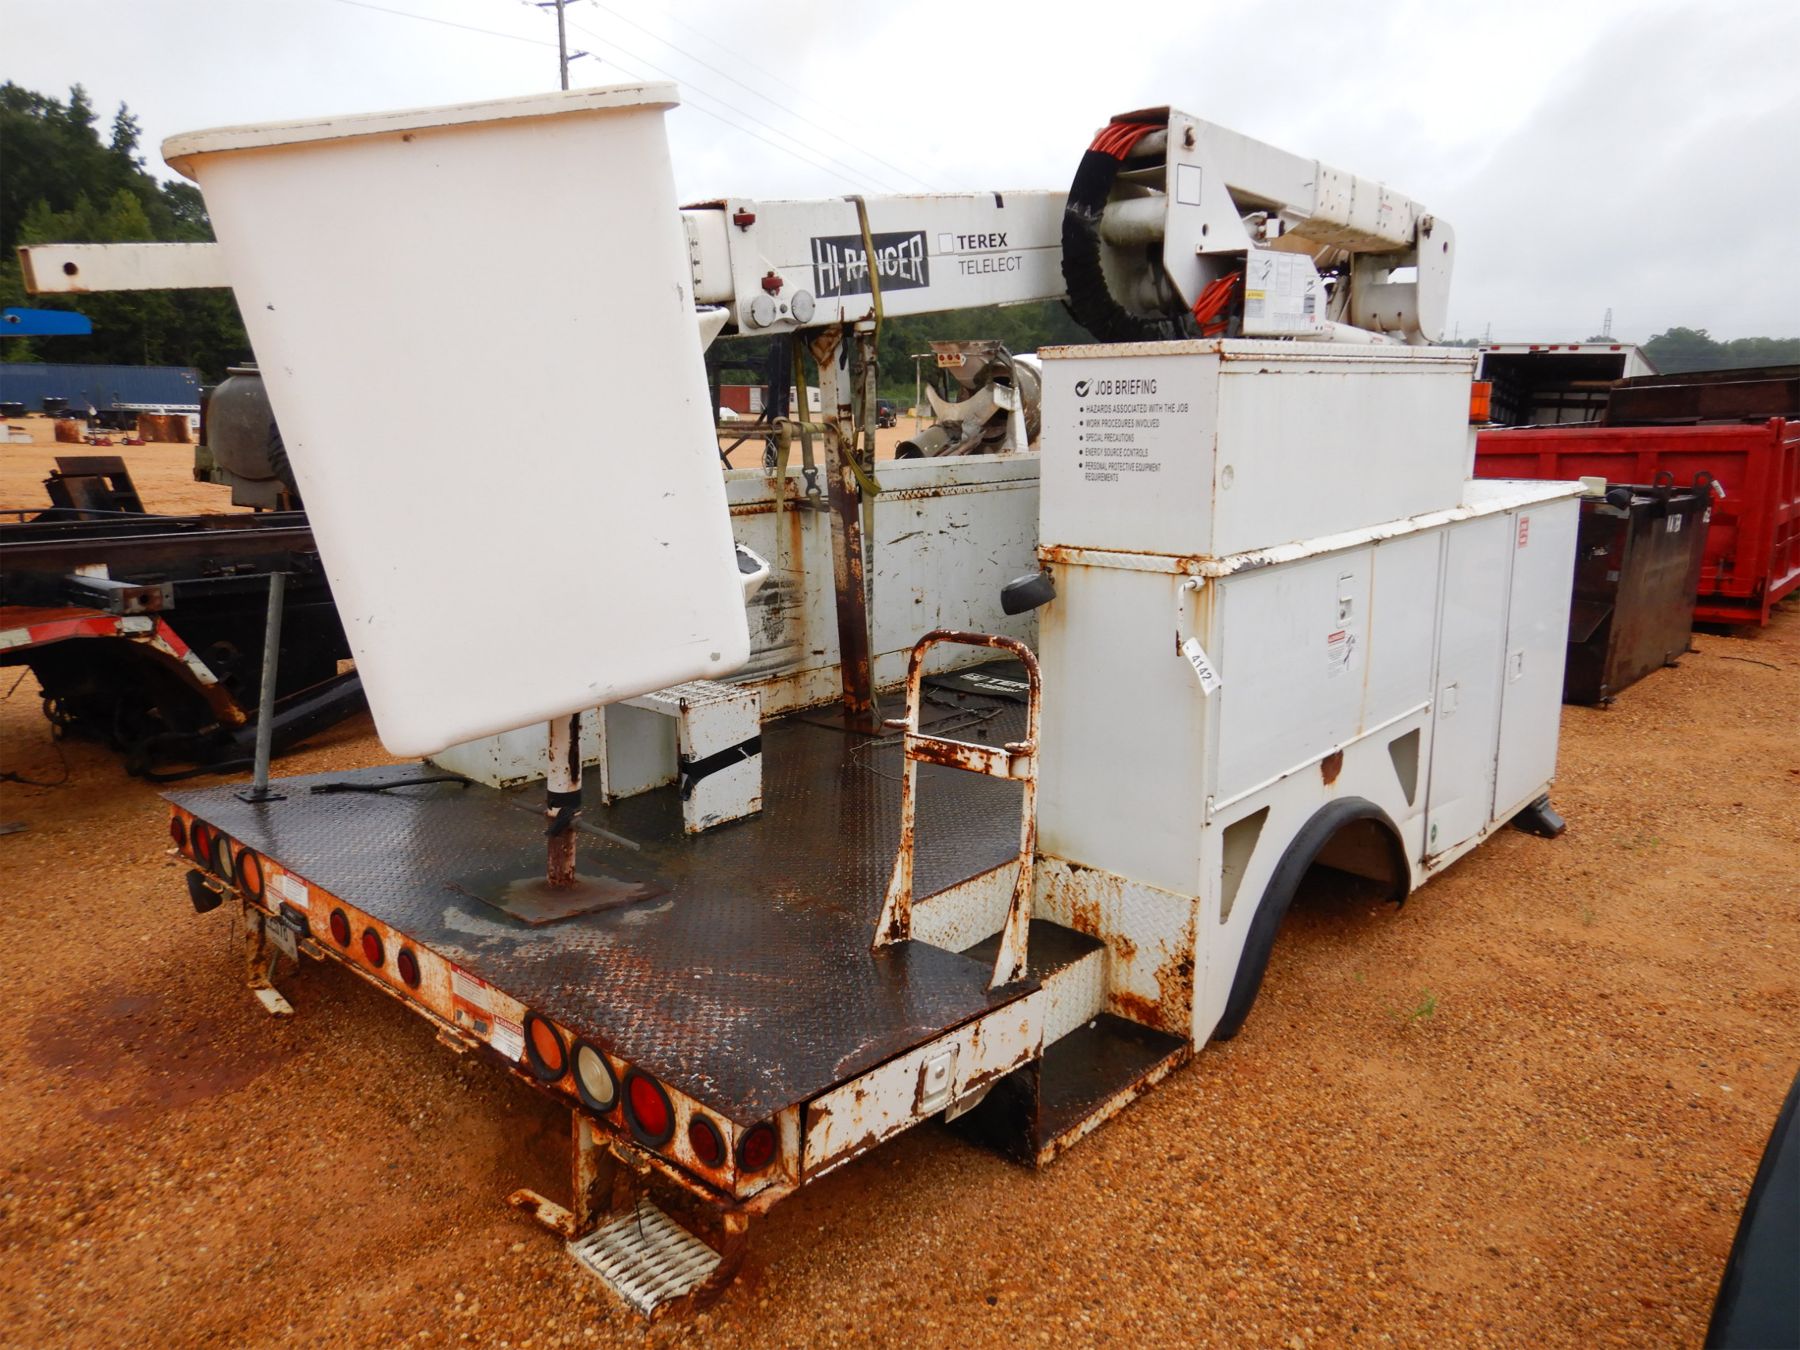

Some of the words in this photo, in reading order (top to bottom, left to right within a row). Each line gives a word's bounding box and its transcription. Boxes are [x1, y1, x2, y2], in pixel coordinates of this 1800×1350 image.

[957, 232, 1008, 250] TEREX
[958, 256, 1023, 275] TELELECT
[1095, 380, 1113, 396] JOB
[1115, 379, 1157, 395] BRIEFING
[1086, 404, 1112, 414] HAZARDS
[1113, 404, 1147, 413] ASSOCIATED
[1148, 403, 1163, 413] WITH
[1164, 403, 1175, 413] THE
[1176, 403, 1189, 413] JOB
[1086, 419, 1101, 428] WORK
[1101, 419, 1134, 428] PROCEDURES
[1135, 418, 1160, 428] INVOLVED
[1104, 433, 1135, 442] PRECAUTIONS
[1104, 447, 1123, 457] SOURCE
[1123, 448, 1148, 457] CONTROLS
[1108, 462, 1135, 472] PROTECTIVE
[1135, 462, 1161, 472] EQUIPMENT
[1085, 472, 1119, 482] REQUIREMENTS
[1191, 655, 1213, 681] 4142
